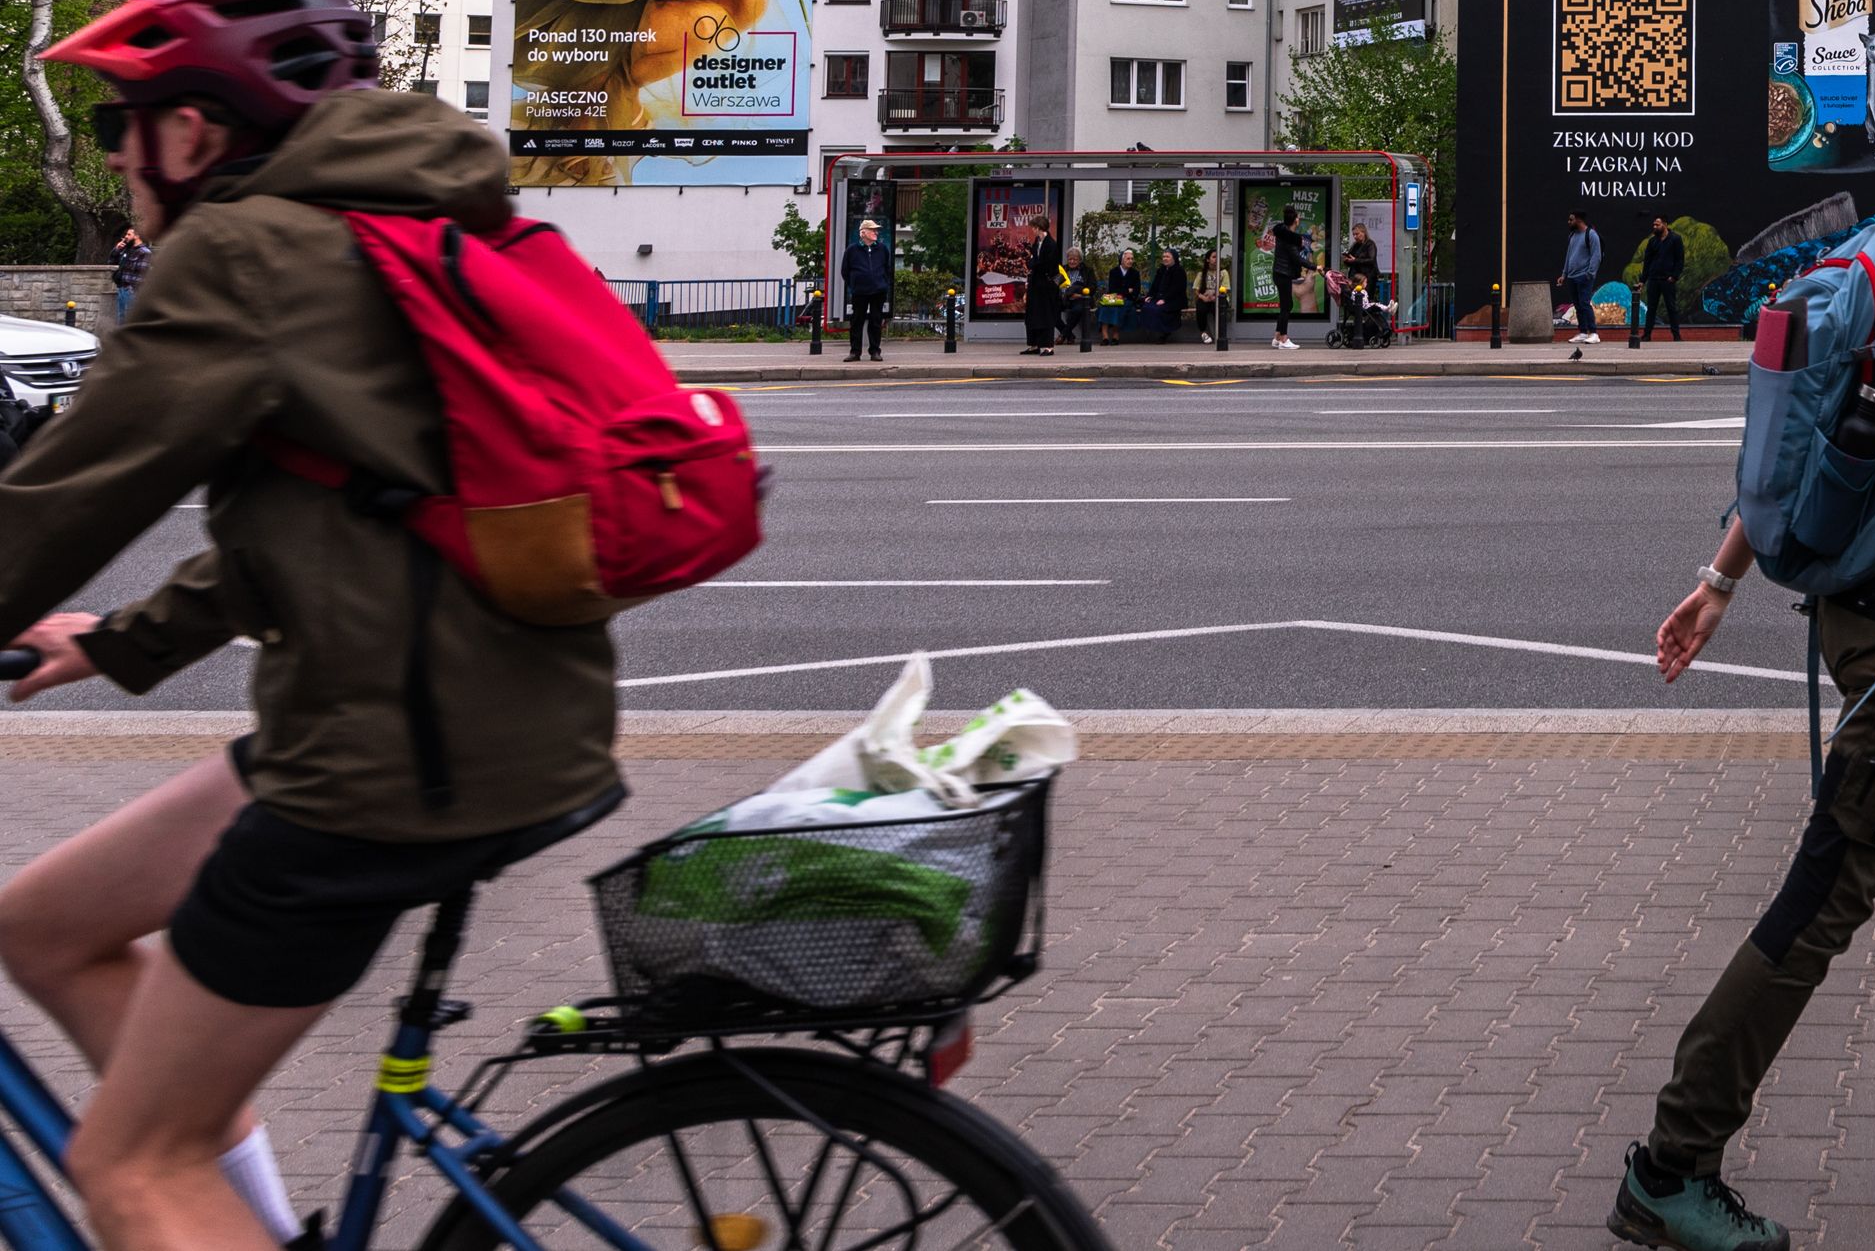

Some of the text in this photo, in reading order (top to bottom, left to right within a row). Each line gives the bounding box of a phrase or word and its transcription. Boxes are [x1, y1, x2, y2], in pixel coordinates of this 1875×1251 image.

[529, 28, 656, 43] Ponad 130 marek
[527, 48, 609, 65] do wyboru
[1812, 47, 1856, 64] Sauce
[693, 54, 786, 75] designer
[692, 73, 756, 89] outlet
[526, 91, 608, 104] PIASECZNO
[692, 93, 780, 108] Warszawa
[526, 105, 607, 117] Puławska 42E
[1553, 131, 1694, 151] ZESKANUJ KOD
[1566, 156, 1682, 176] I ZAGRAJ NA
[1293, 190, 1319, 203] MASZ
[1581, 181, 1666, 197] MURALU!
[1020, 205, 1043, 215] WILD
